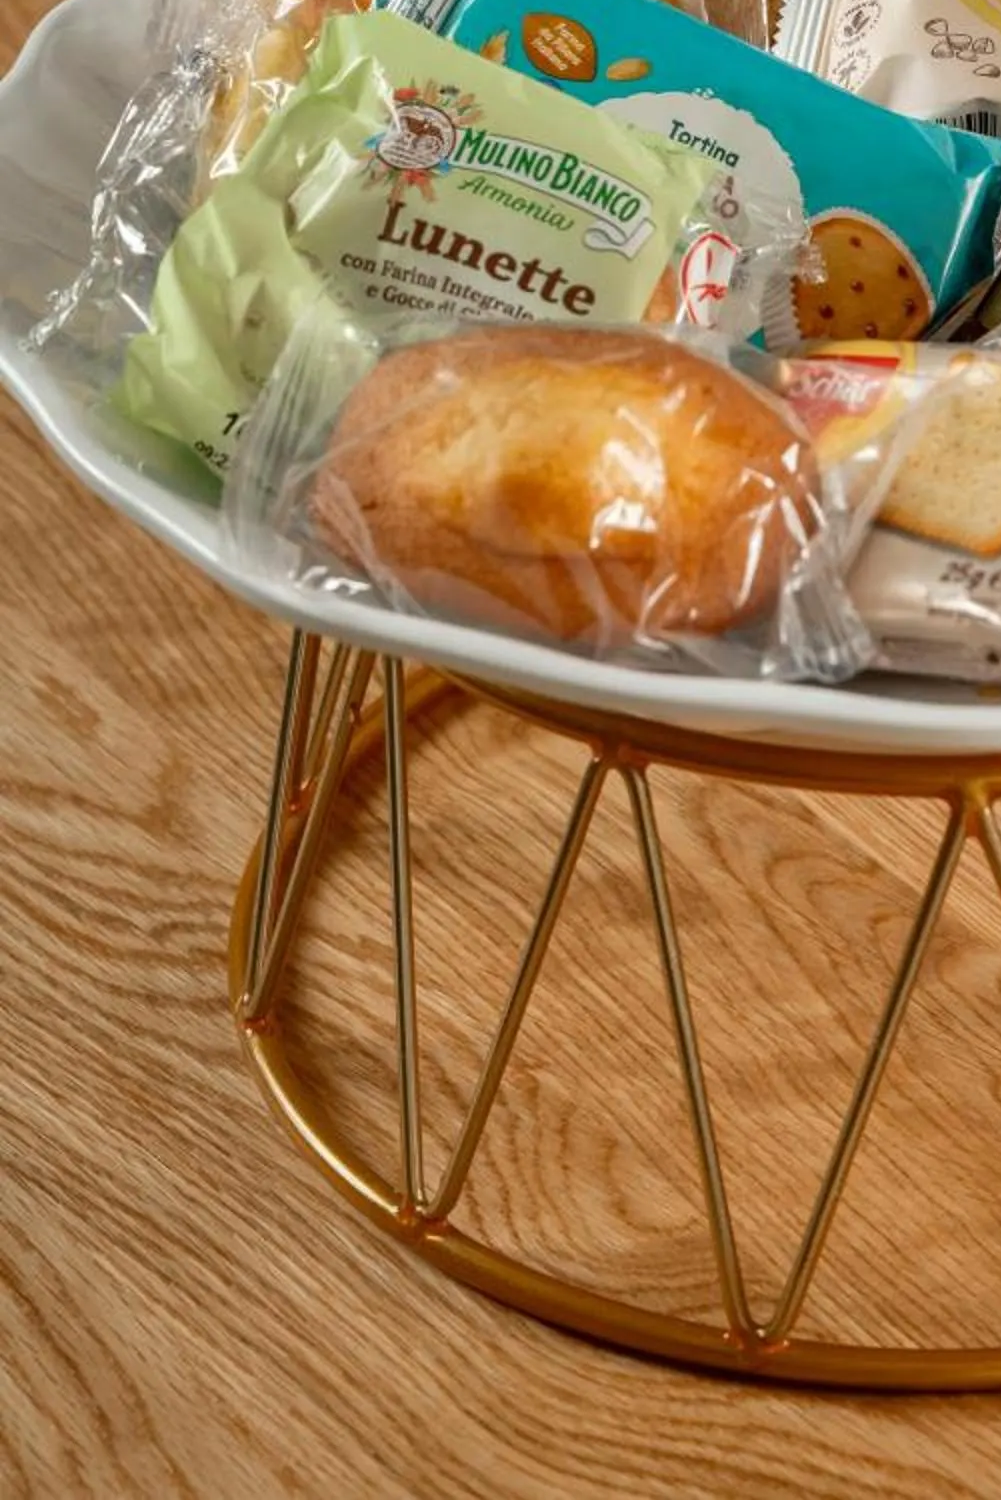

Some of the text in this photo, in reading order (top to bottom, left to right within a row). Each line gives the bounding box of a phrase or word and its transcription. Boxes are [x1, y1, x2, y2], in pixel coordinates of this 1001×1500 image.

[668, 119, 741, 169] Tortina
[458, 175, 577, 232] Armonia
[339, 252, 377, 274] con
[380, 259, 438, 291] Farina
[377, 197, 597, 317] Lunette
[365, 284, 379, 298] e
